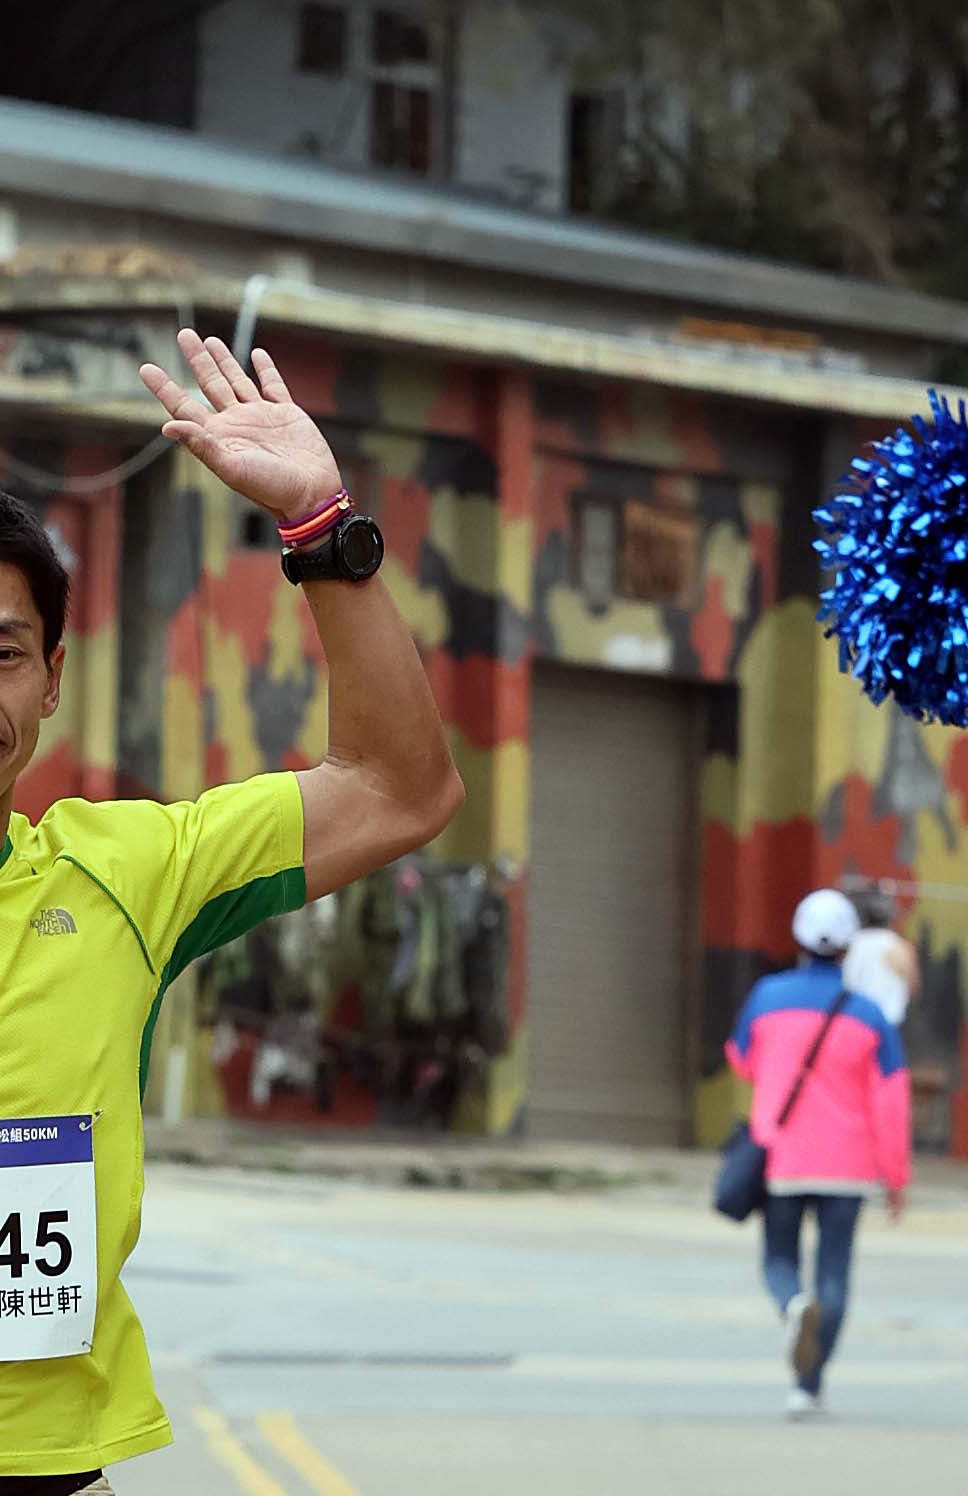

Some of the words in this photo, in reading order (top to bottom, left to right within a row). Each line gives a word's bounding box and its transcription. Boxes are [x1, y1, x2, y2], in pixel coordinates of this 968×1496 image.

[40, 909, 56, 920] THE
[30, 918, 57, 928] NORTH
[38, 926, 62, 936] FACE
